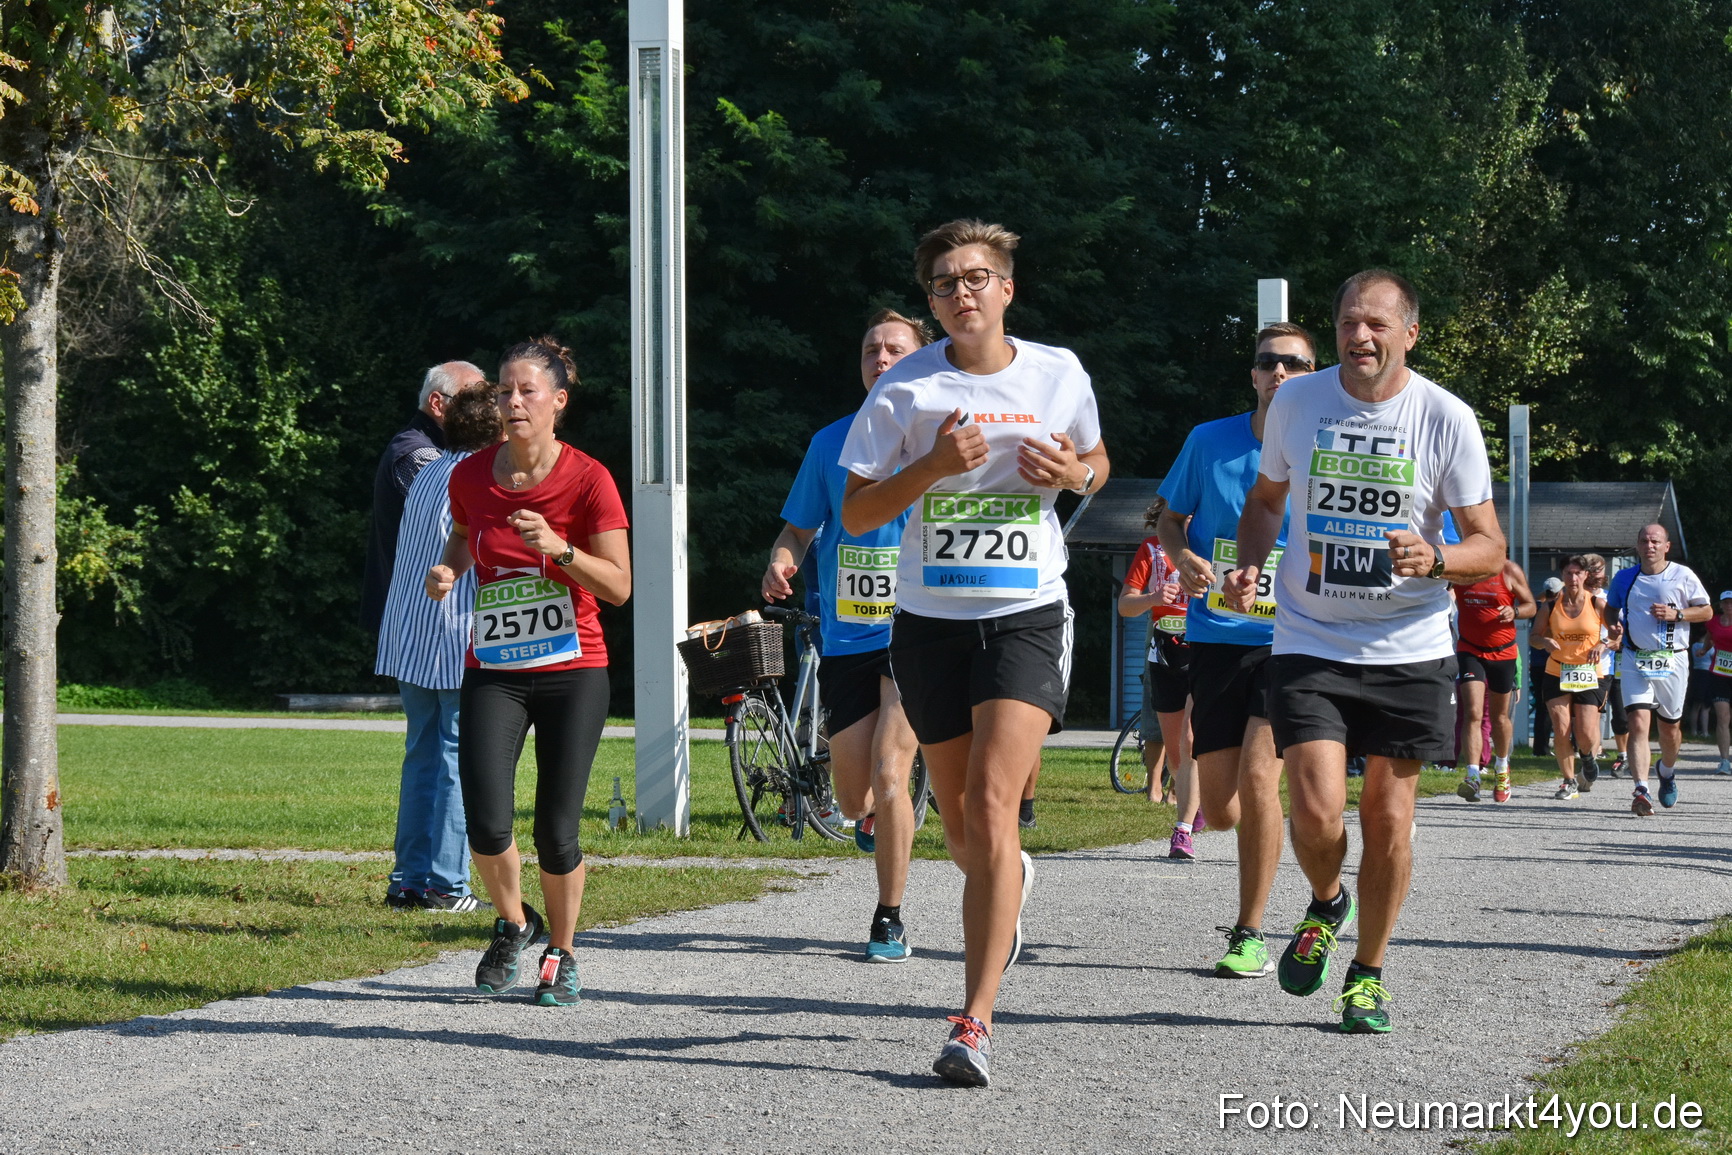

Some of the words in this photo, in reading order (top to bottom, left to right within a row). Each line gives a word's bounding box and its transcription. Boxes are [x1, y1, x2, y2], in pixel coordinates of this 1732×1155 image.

[974, 413, 1041, 424] KLEBL
[1319, 417, 1333, 425] DIE
[1335, 419, 1355, 428] NEUE
[1358, 423, 1407, 434] WOHNFORMEL
[1318, 455, 1406, 482] BOCK
[930, 495, 1033, 522] BOCK
[1317, 482, 1401, 518] 2589
[1324, 520, 1388, 538] ALBERT
[935, 529, 1029, 561] 2720
[1332, 544, 1375, 573] RW
[846, 573, 896, 597] 103
[939, 573, 988, 585] NADINE
[481, 580, 554, 605] BOCK
[1323, 588, 1392, 600] RAUMWERK
[853, 604, 894, 615] TOBIA
[483, 604, 563, 642] 2570
[499, 641, 553, 660] STEFFI
[1639, 660, 1670, 670] 2194
[1565, 672, 1593, 682] 1303
